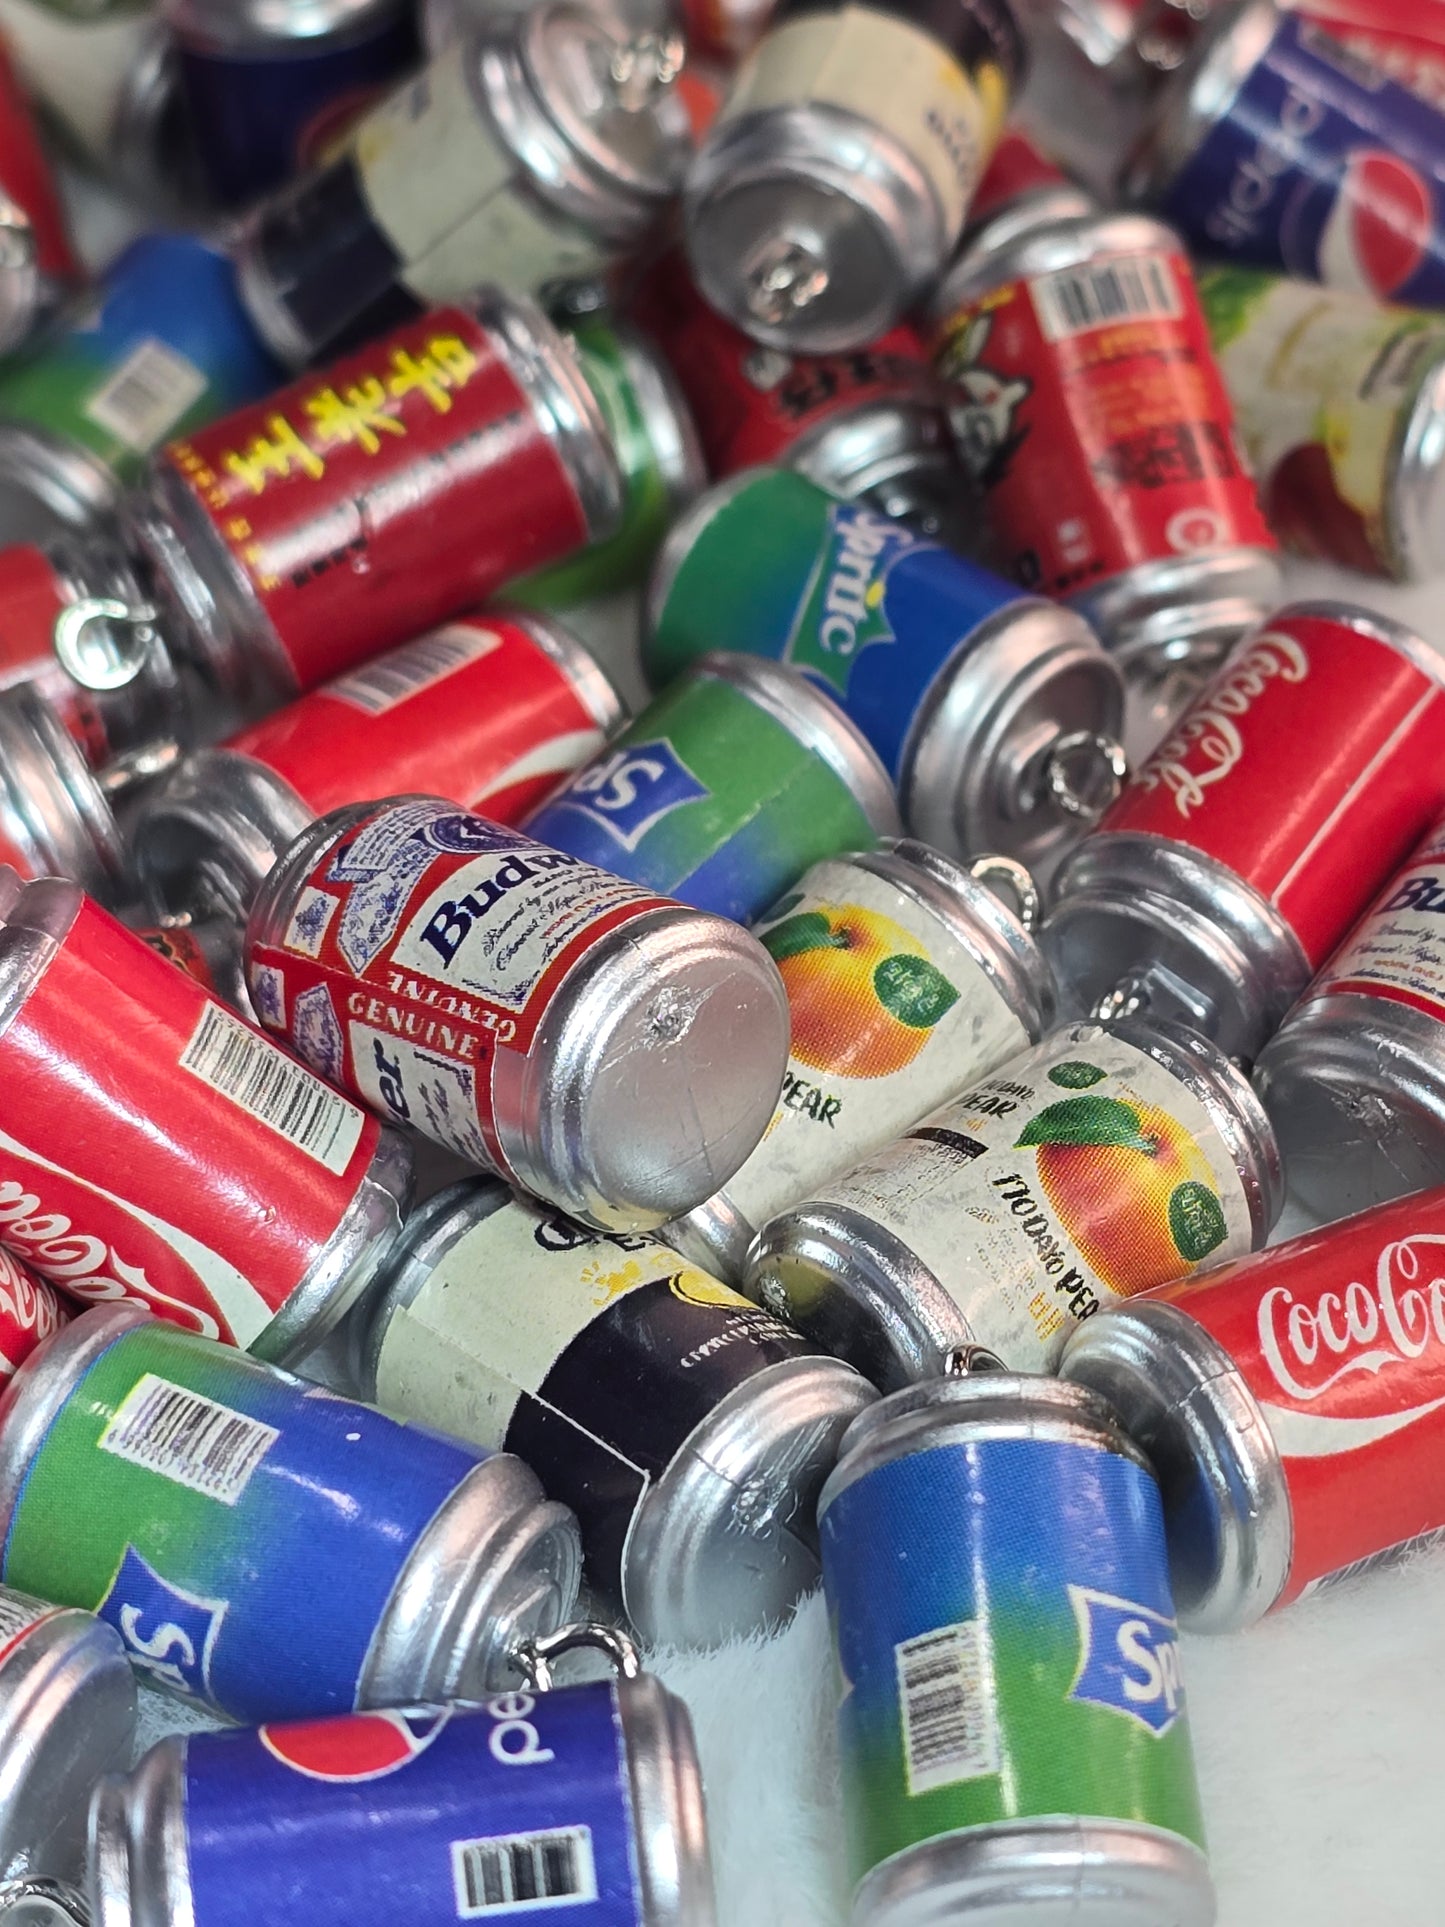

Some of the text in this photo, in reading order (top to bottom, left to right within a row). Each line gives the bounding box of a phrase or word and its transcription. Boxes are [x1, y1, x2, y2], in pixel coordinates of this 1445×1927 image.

[222, 335, 478, 496] 王老吉
[347, 992, 480, 1061] GENUINE
[373, 1037, 411, 1123] er
